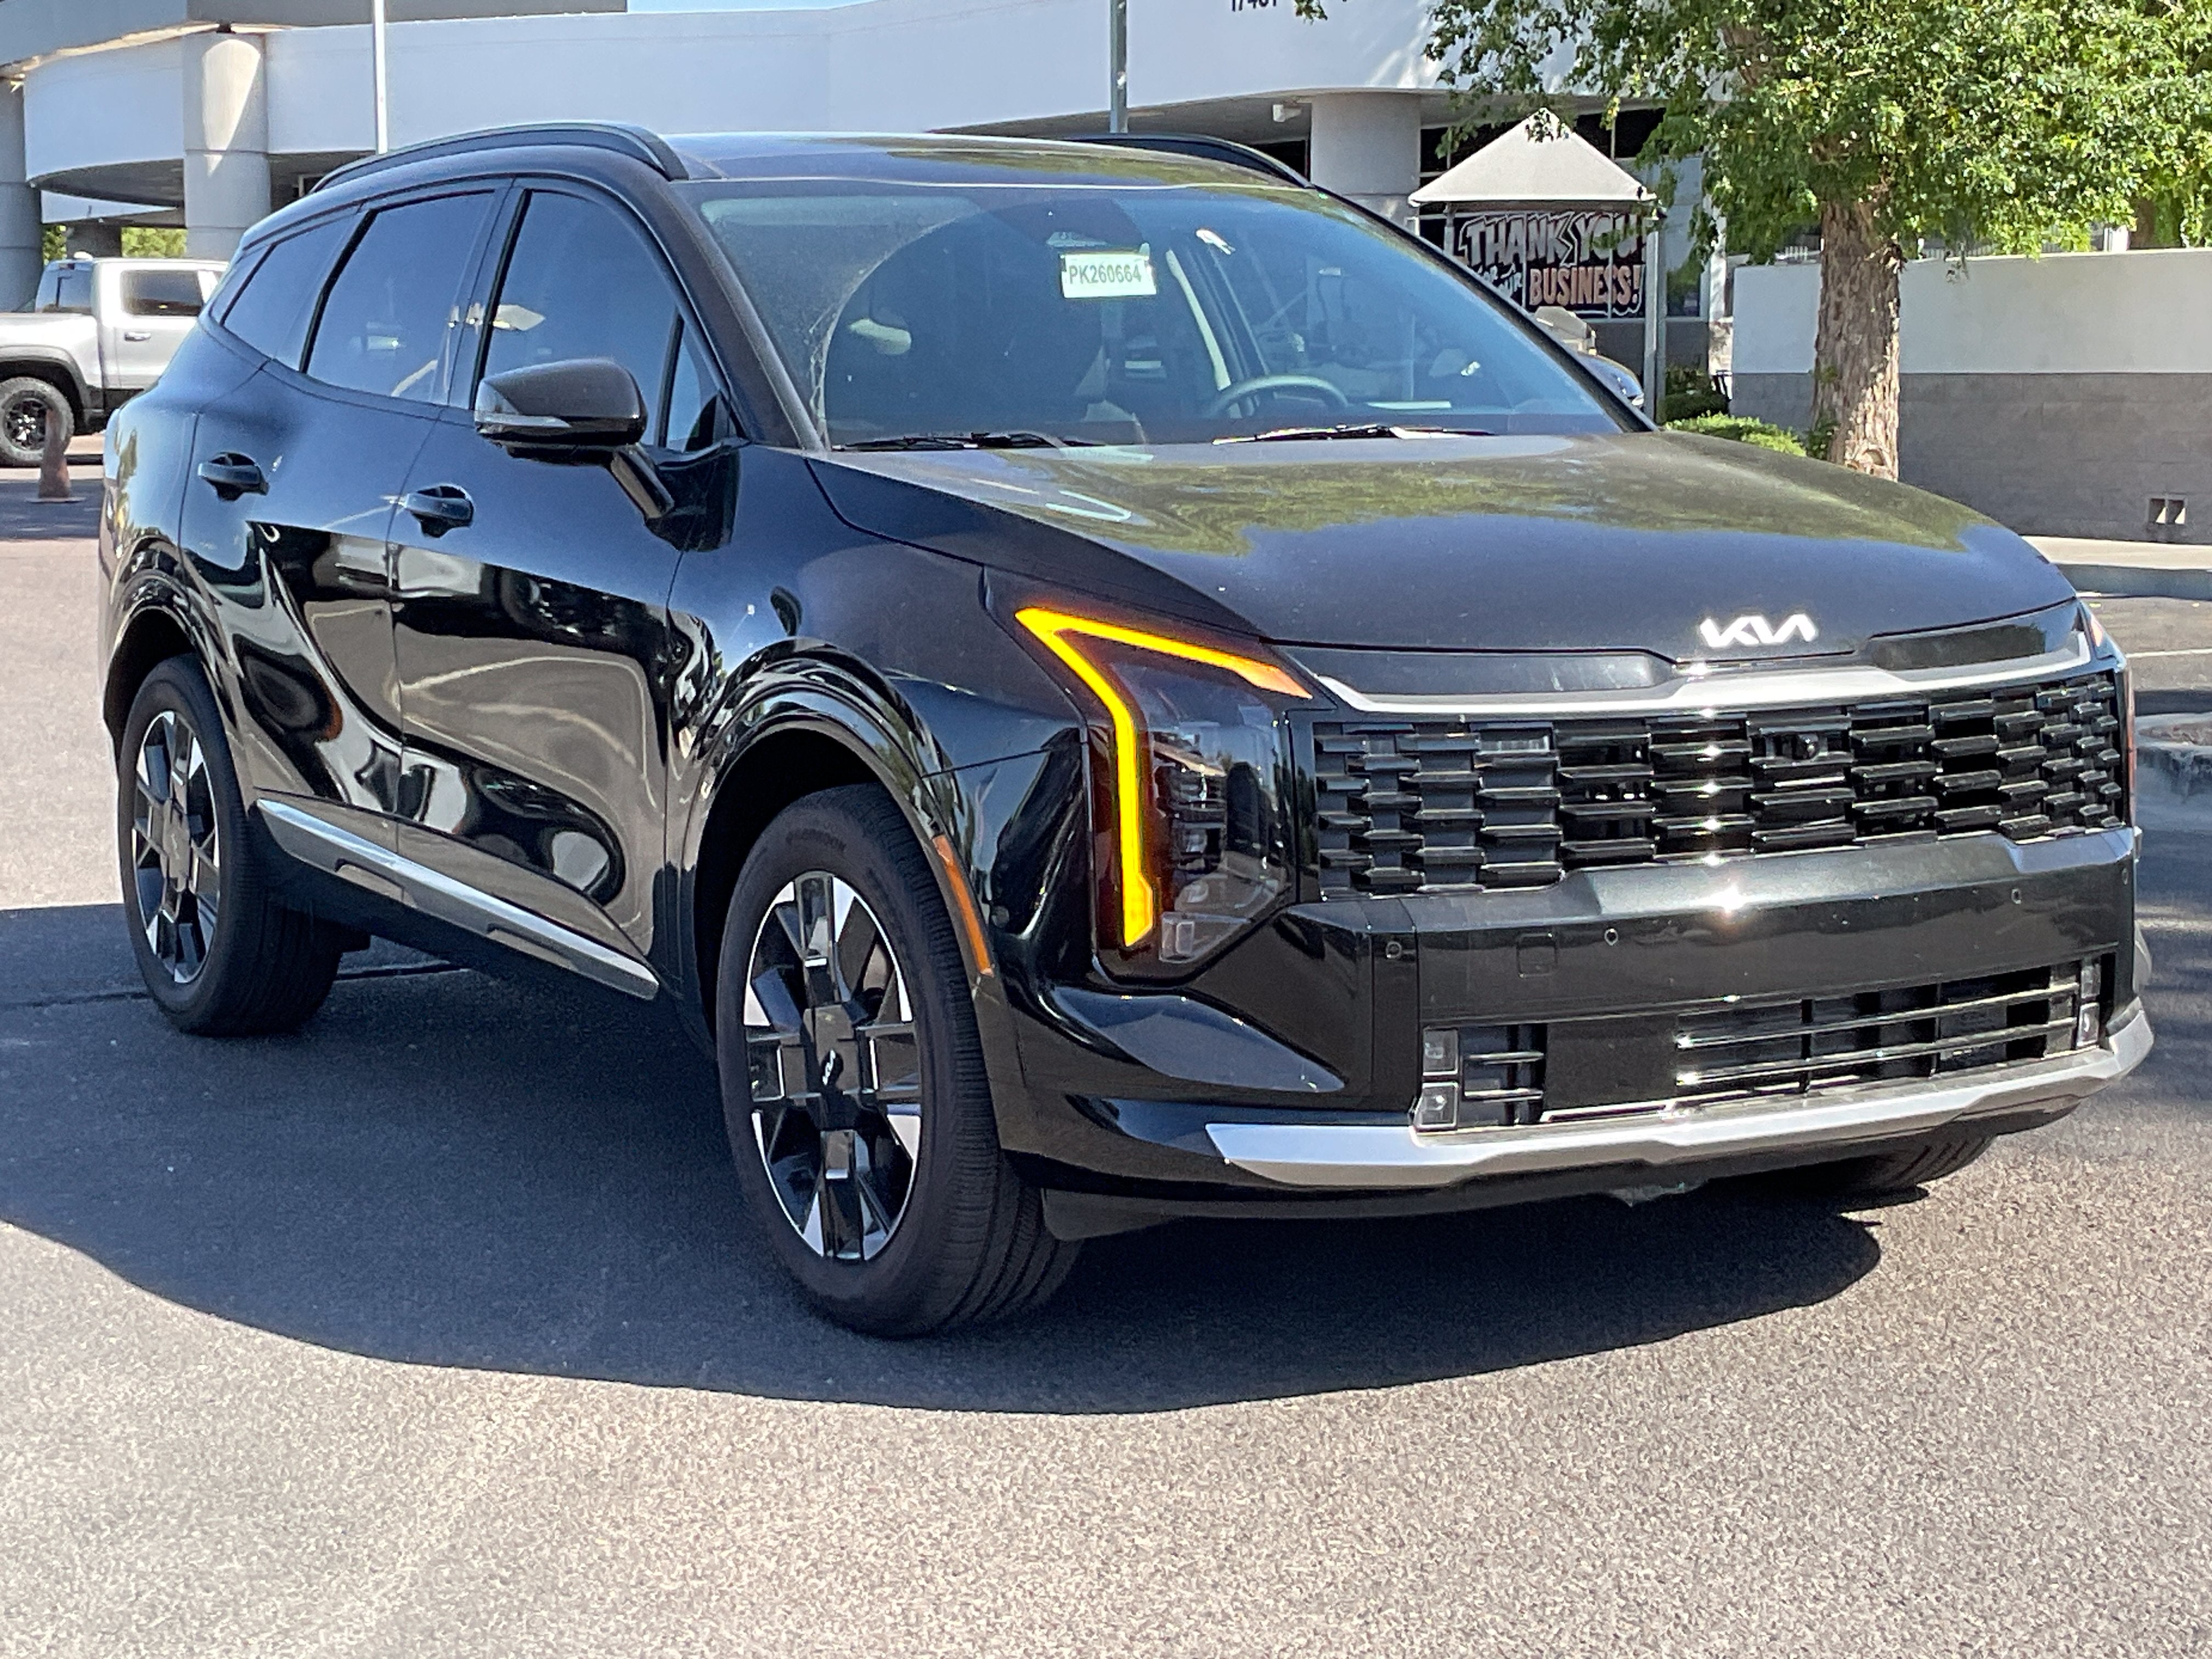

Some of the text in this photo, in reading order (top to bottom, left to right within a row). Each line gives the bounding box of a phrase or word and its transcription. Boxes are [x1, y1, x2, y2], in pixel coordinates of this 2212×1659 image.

[1466, 217, 1568, 267] THANK
[1068, 263, 1142, 284] PK260664
[1528, 264, 1641, 306] BUSINESS!
